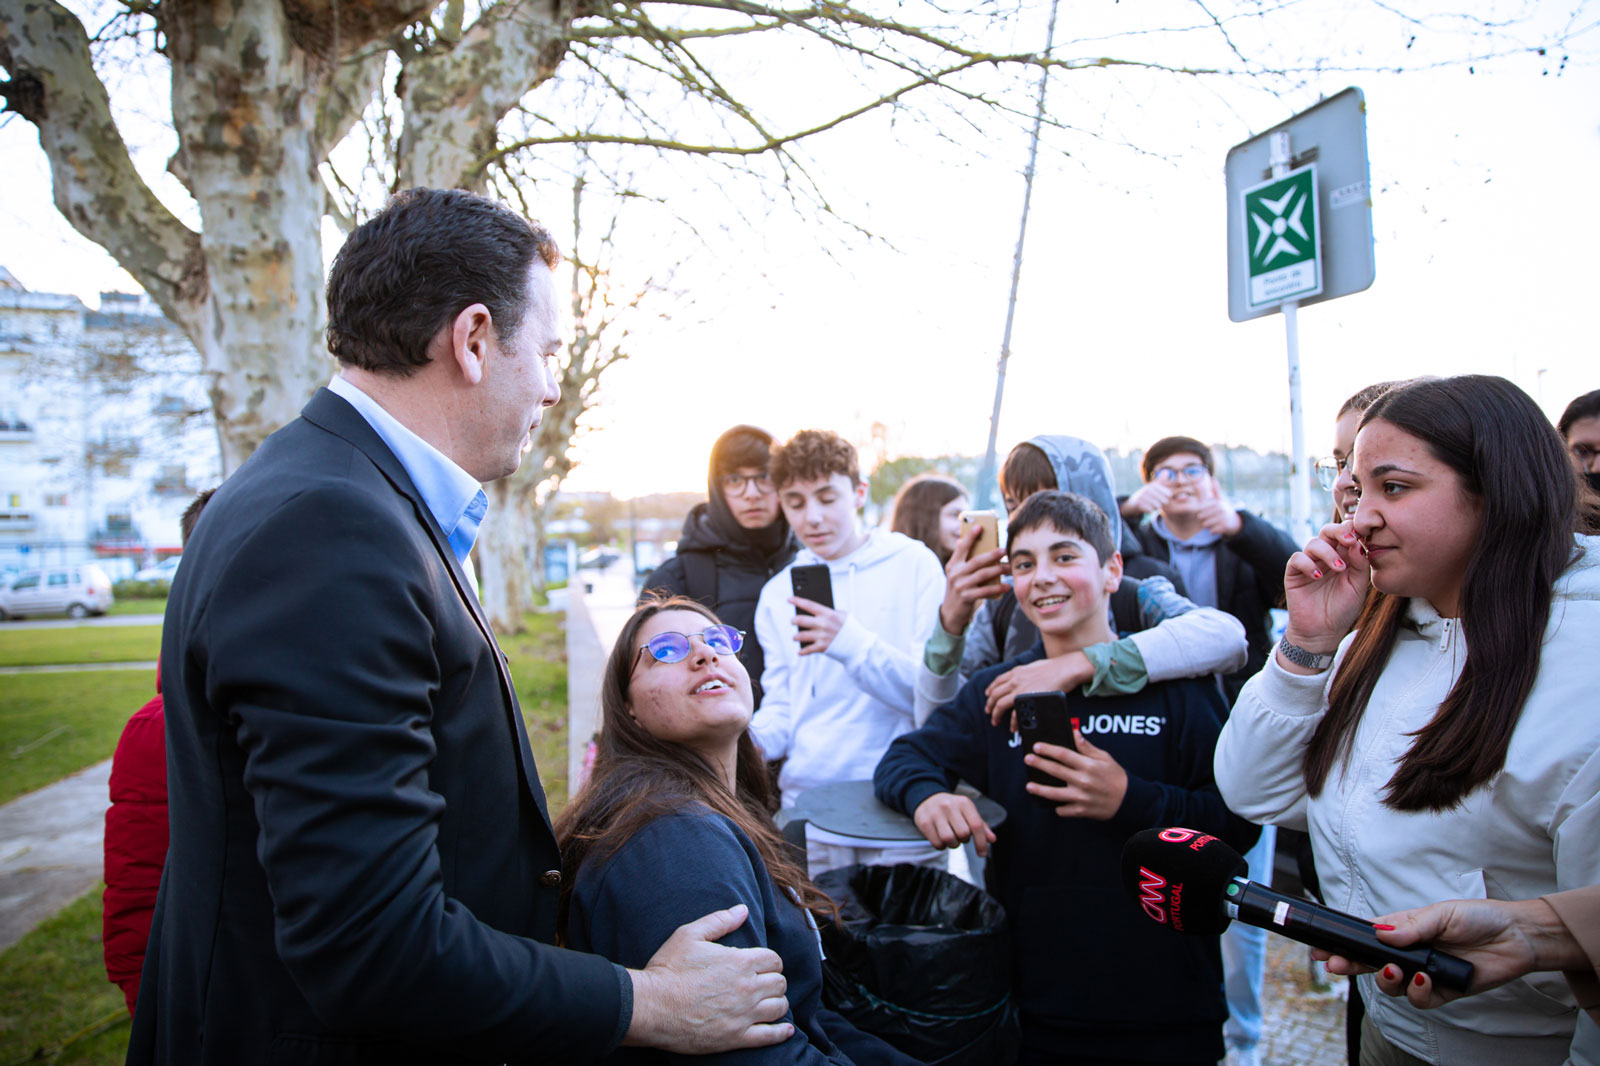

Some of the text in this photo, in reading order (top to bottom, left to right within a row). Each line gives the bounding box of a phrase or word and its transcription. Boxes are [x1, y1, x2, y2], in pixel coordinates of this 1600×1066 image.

[1081, 714, 1161, 736] JONES
[1138, 865, 1168, 924] CNN
[1169, 882, 1184, 932] PORTUGAL
